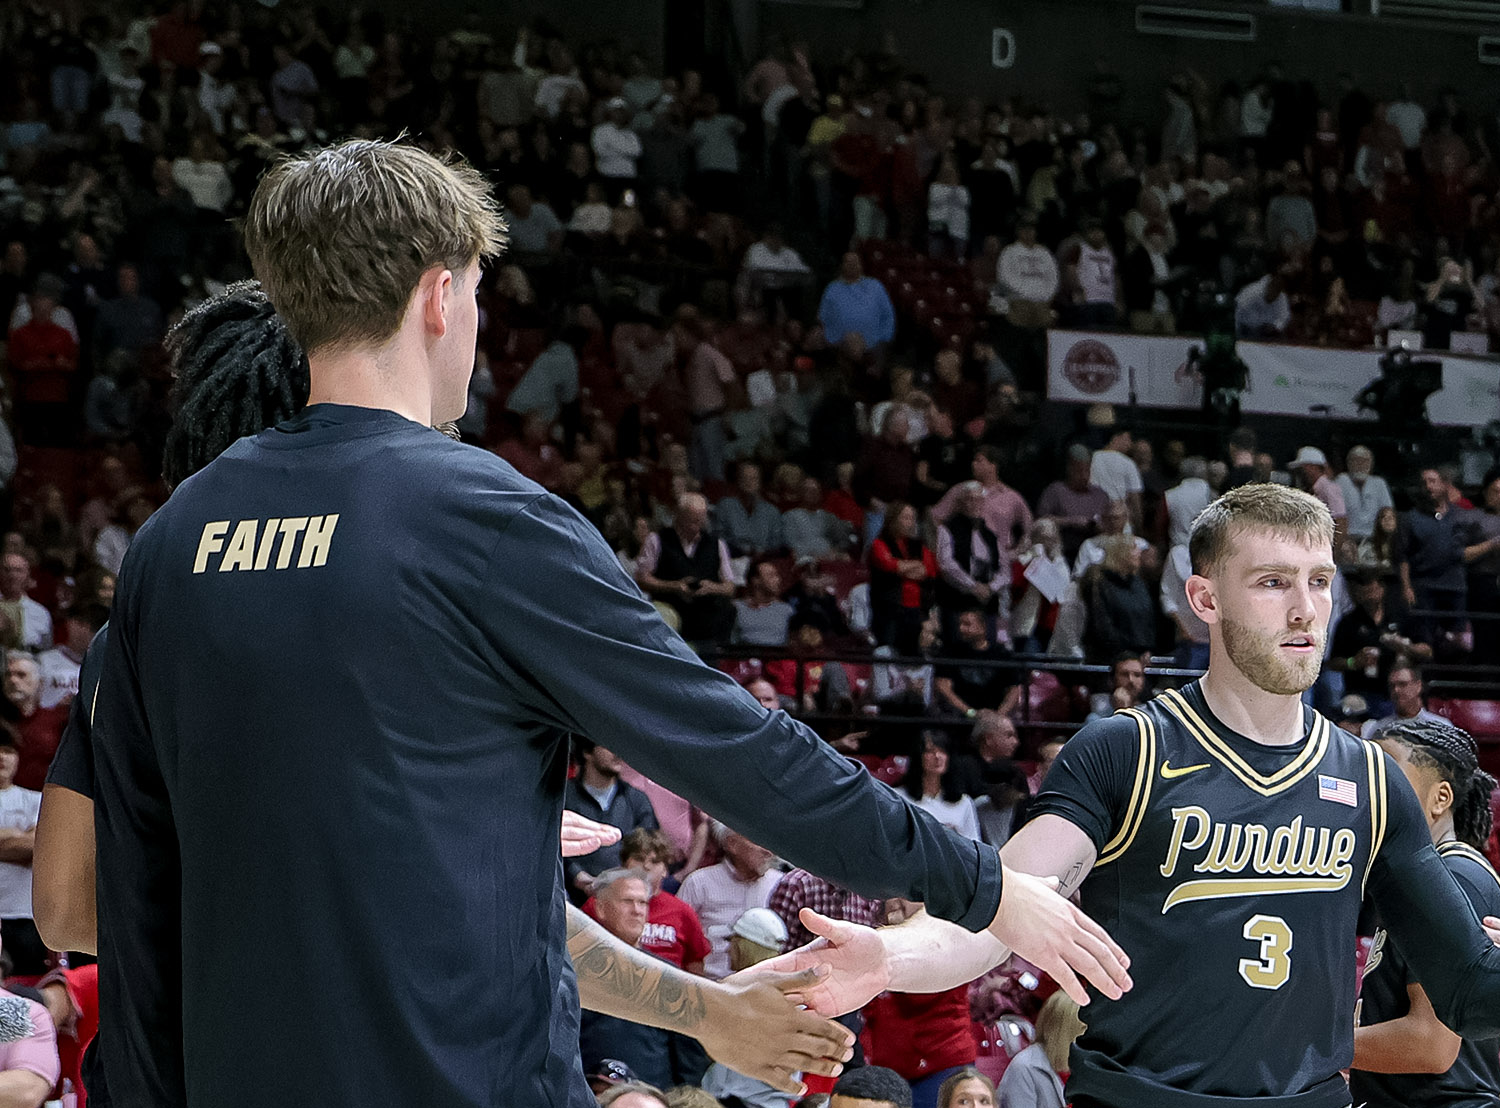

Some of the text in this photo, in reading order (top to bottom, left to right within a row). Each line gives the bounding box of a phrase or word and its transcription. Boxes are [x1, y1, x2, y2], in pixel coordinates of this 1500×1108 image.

[992, 28, 1016, 69] D
[193, 513, 340, 574] FAITH
[1160, 805, 1356, 880] Purdue
[1238, 913, 1293, 990] 3
